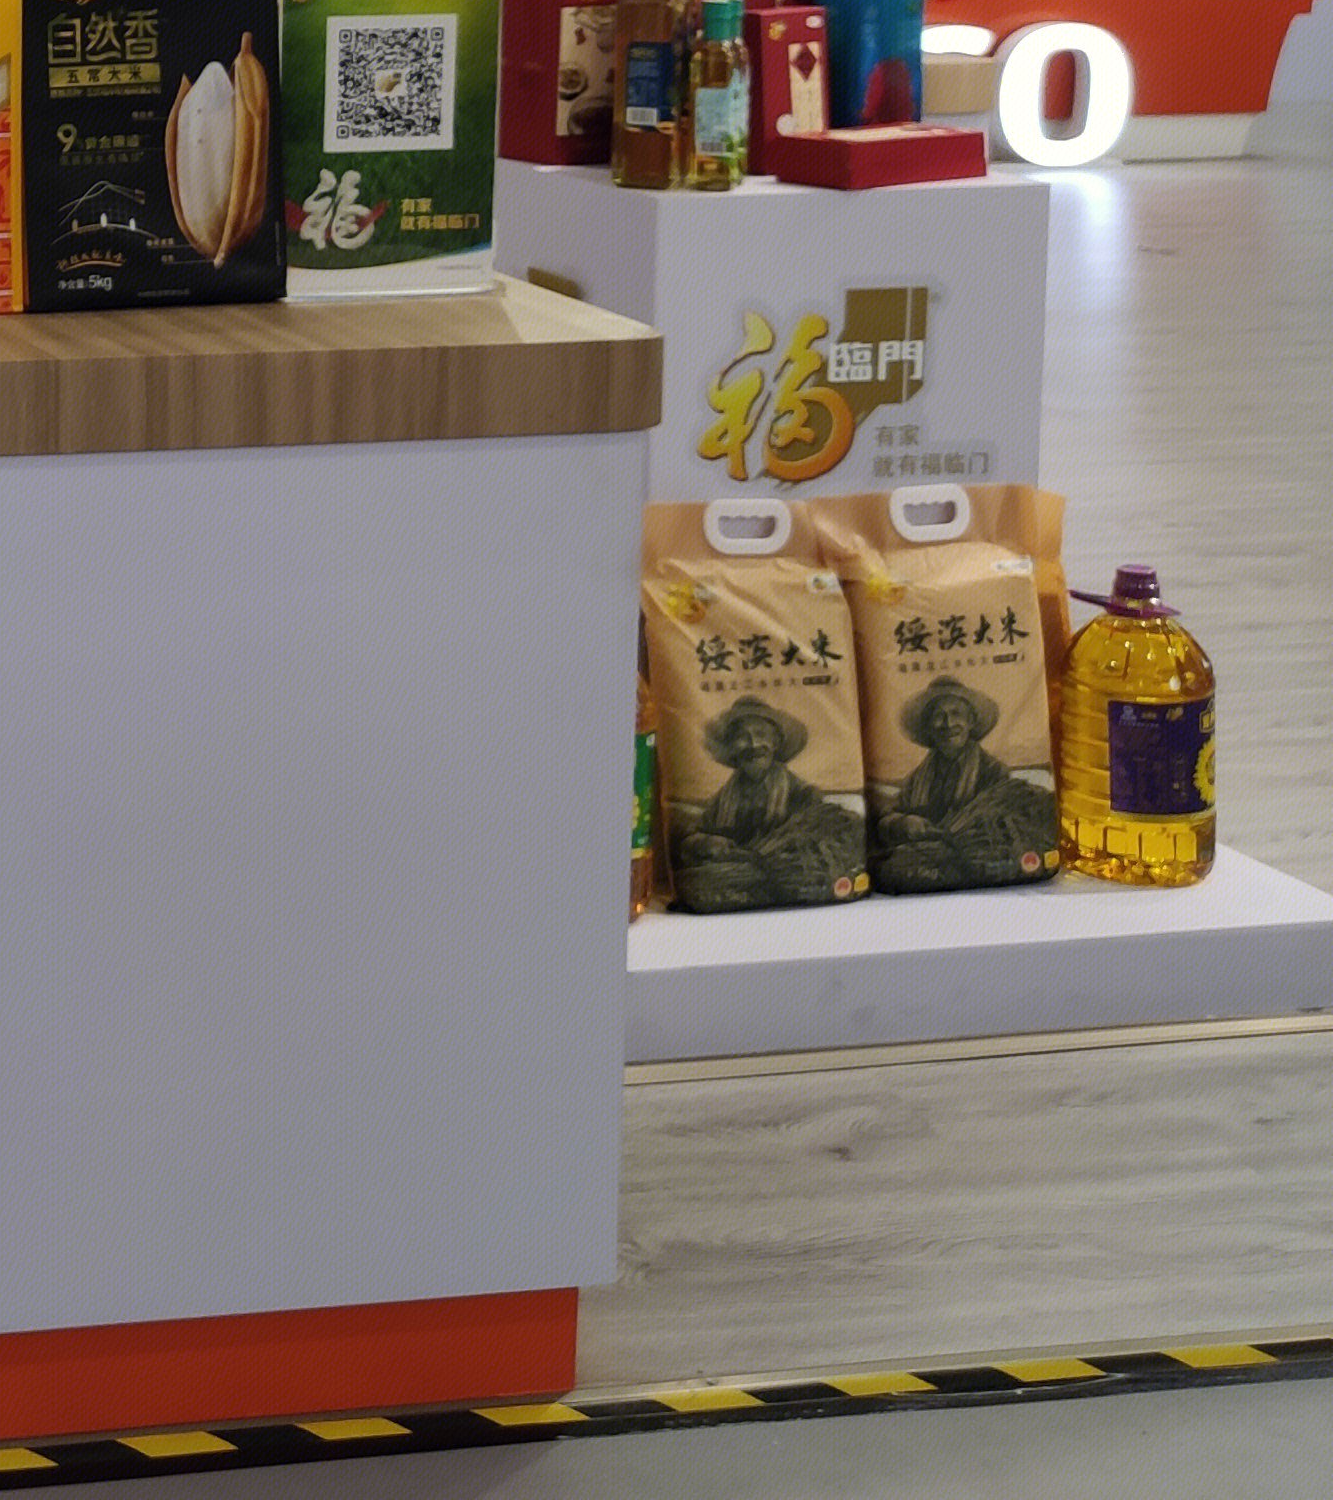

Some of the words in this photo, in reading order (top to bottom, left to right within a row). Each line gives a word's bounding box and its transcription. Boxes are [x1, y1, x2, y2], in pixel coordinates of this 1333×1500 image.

[47, 8, 159, 65] 自然香
[66, 66, 143, 84] 五常大米
[299, 168, 375, 250] 福
[696, 308, 856, 482] 福
[875, 424, 921, 448] 有家
[872, 451, 991, 480] 就有福临门
